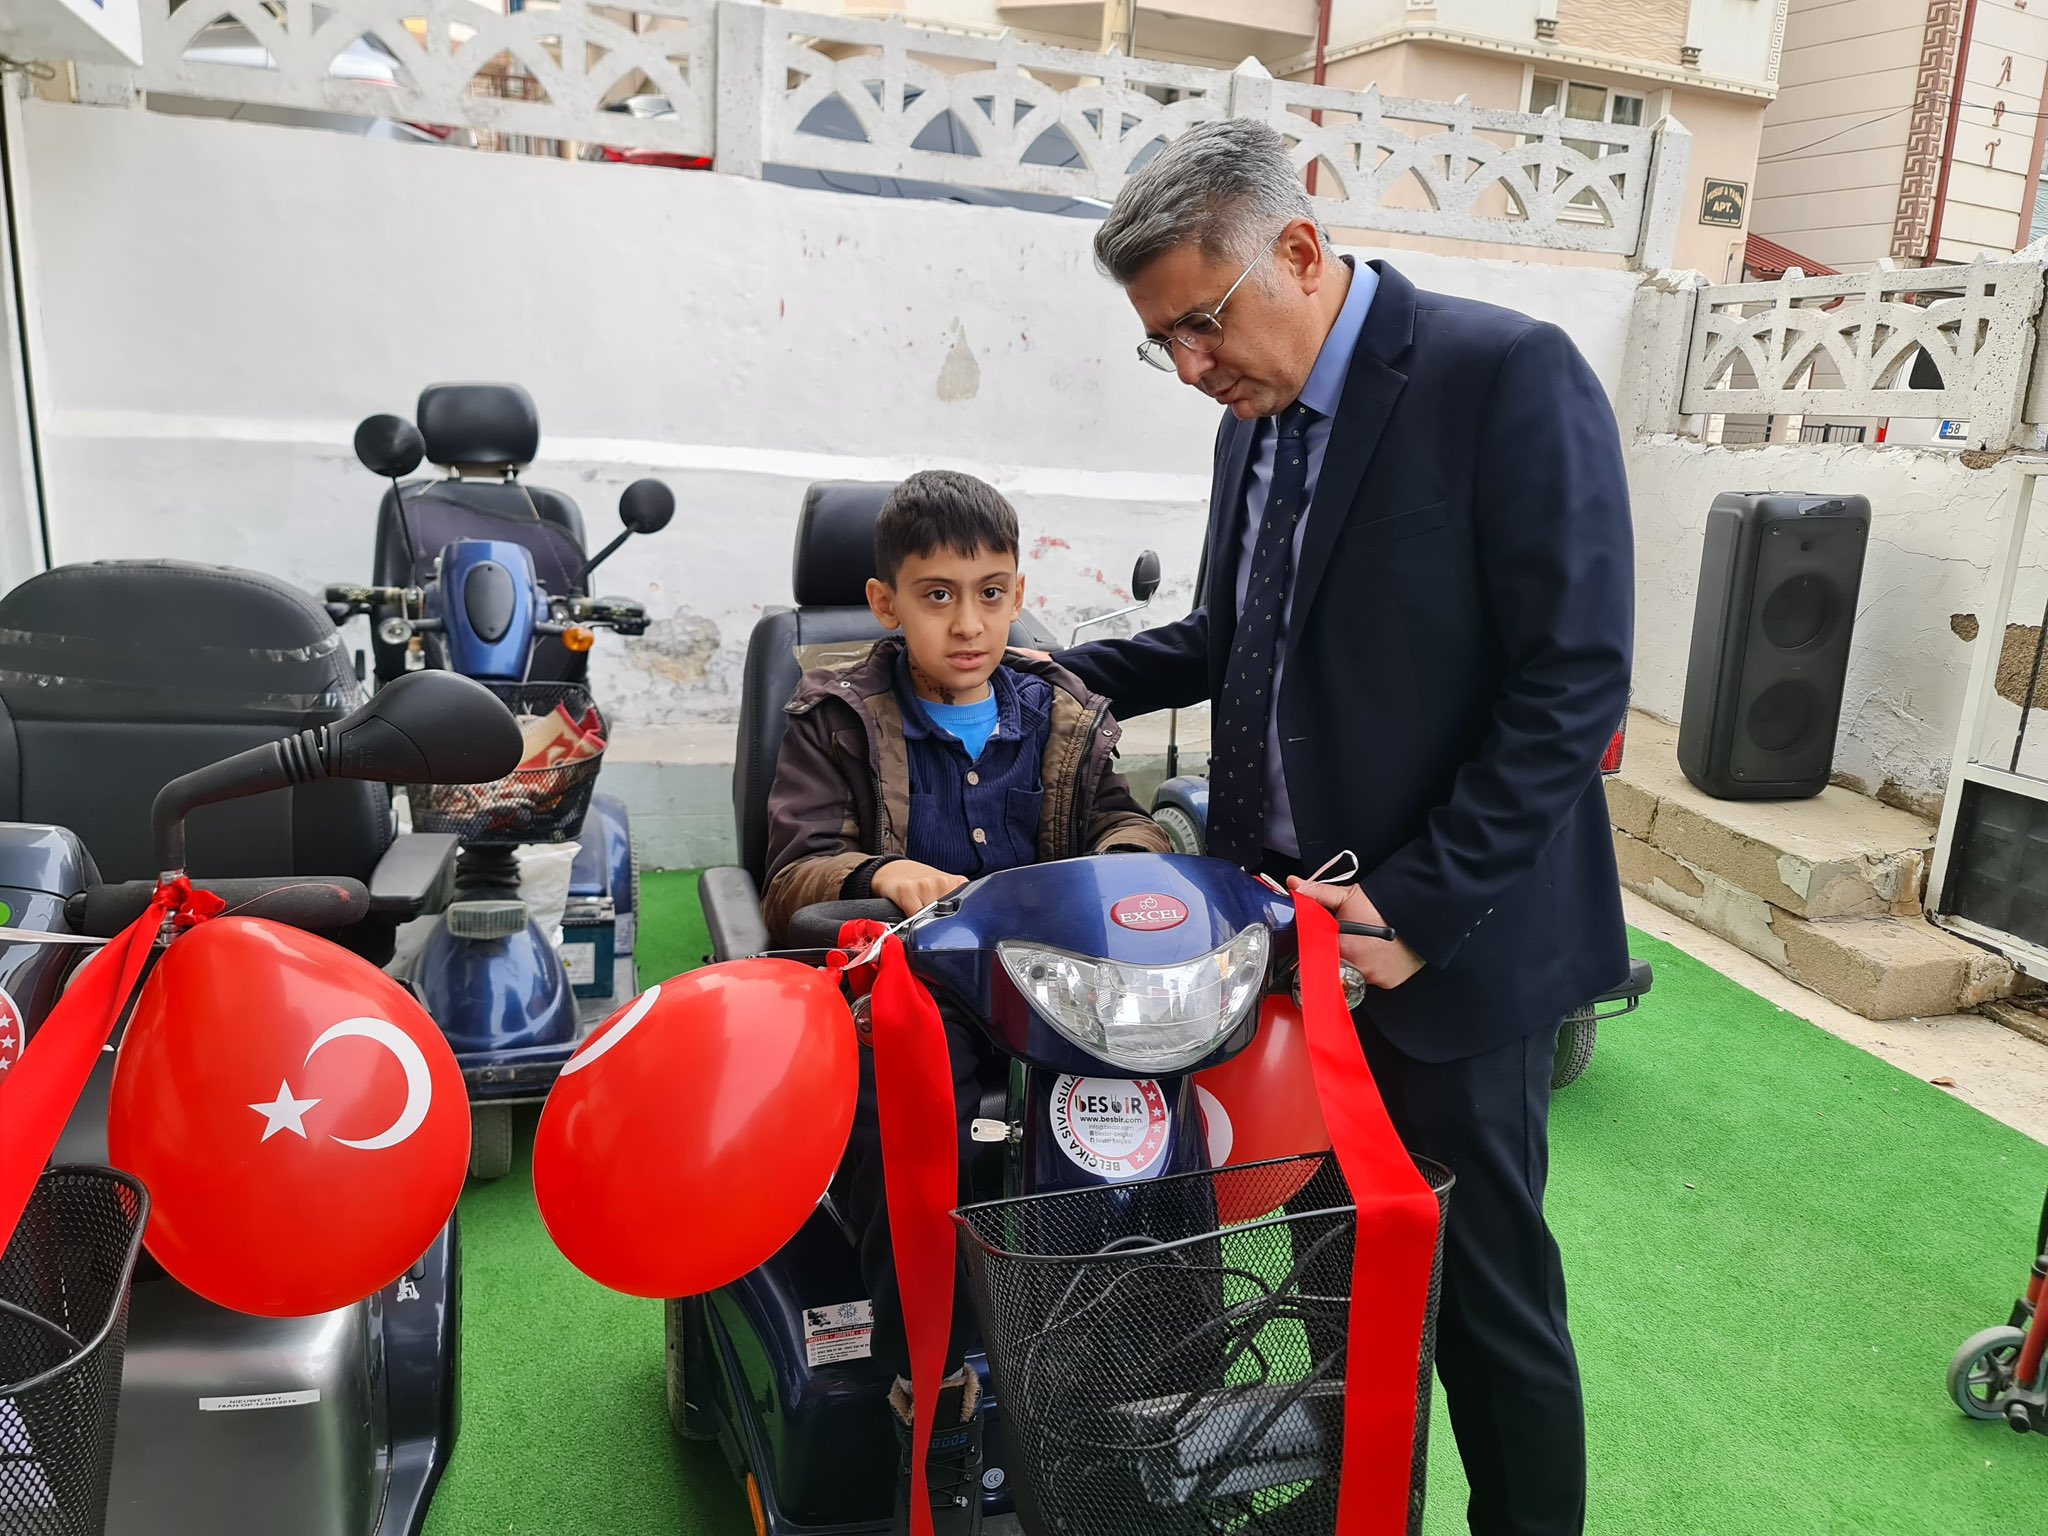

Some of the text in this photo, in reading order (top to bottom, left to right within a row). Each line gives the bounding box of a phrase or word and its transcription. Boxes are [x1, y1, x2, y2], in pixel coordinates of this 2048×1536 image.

[1712, 201, 1733, 213] APT.
[1948, 423, 1961, 434] 58
[1119, 909, 1184, 923] EXCEL
[1080, 1116, 1142, 1124] www.besbir.com
